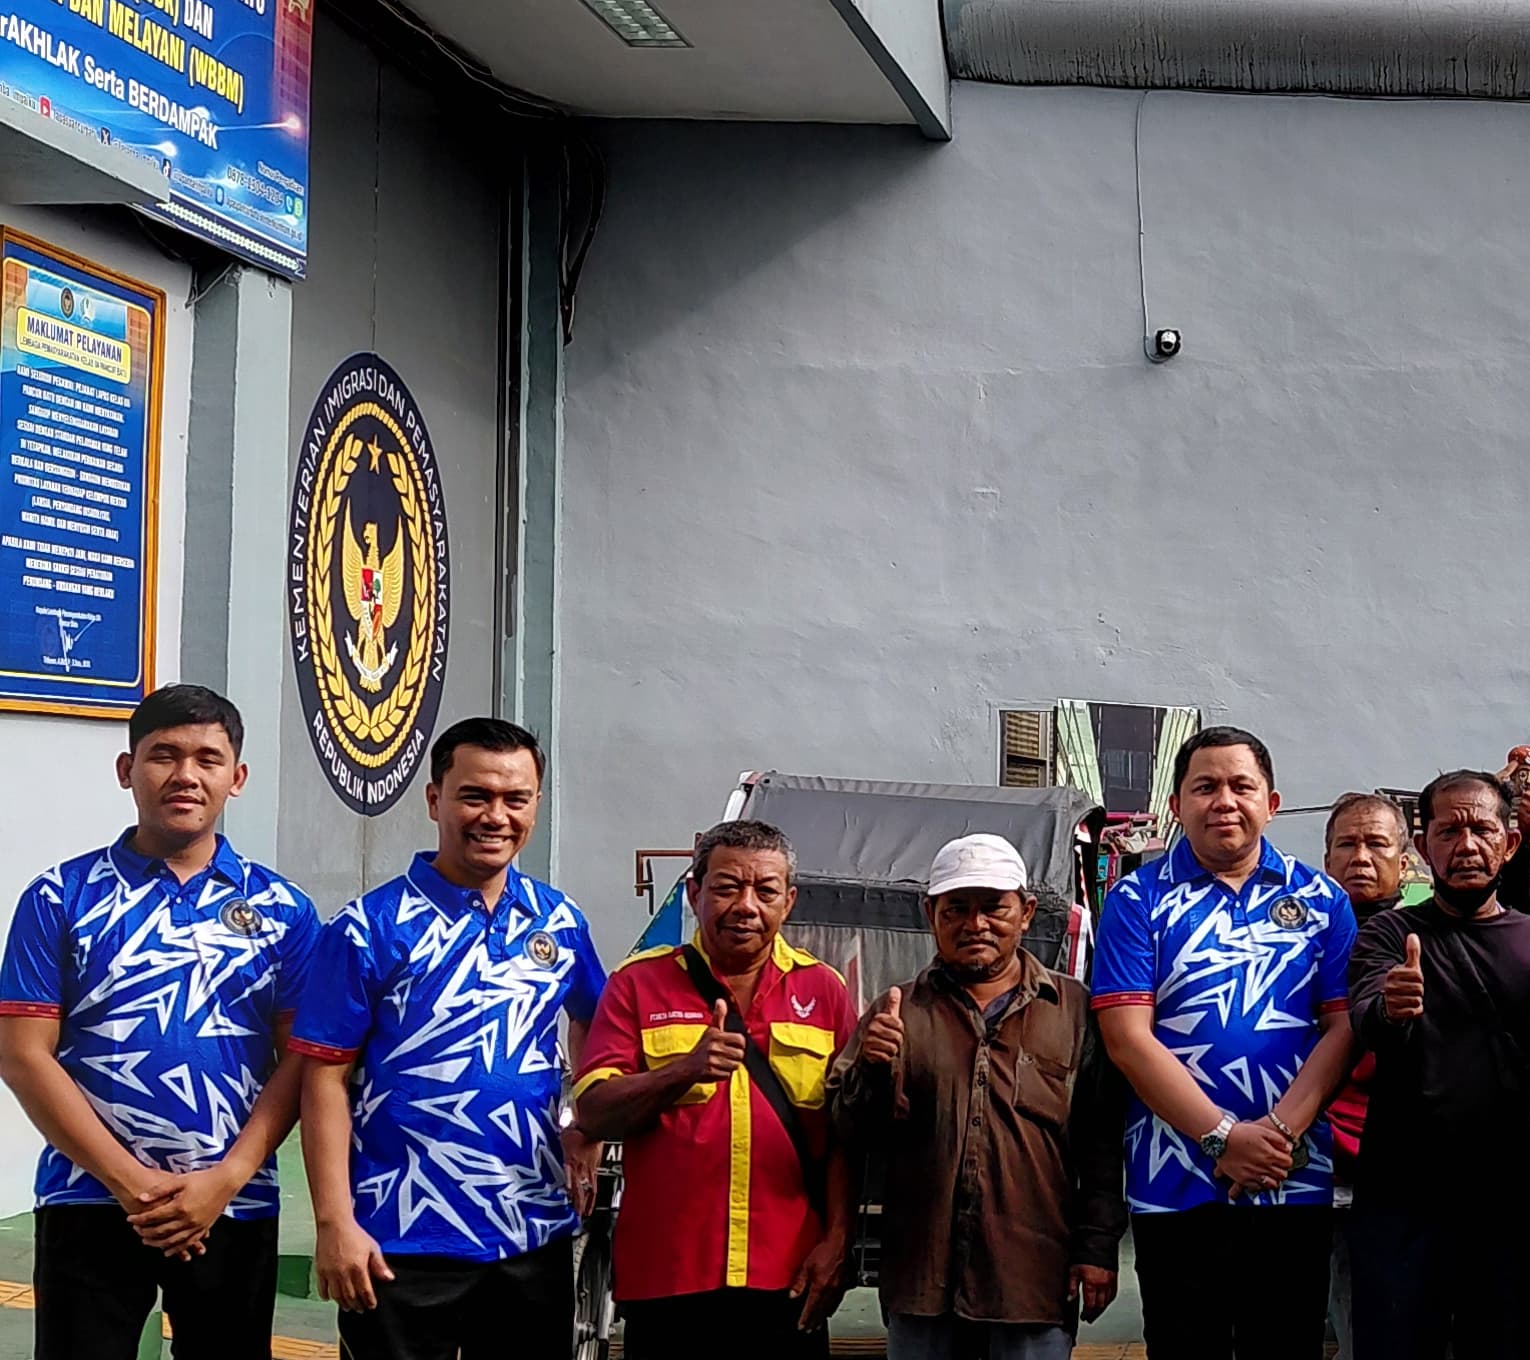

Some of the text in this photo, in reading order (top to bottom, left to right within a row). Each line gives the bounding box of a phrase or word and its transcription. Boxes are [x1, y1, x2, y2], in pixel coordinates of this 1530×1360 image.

[84, 55, 125, 100] Serta
[128, 79, 218, 150] BERDAMPAK
[189, 46, 244, 114] (WBBM)
[27, 316, 74, 347] MAKLUMAT
[76, 333, 122, 363] PELAYANAN
[290, 368, 451, 683] KEMENTERIAN IMIGRASI DAN PEMASYARAKATAN
[313, 710, 425, 804] REPUBLIK NDONESIA
